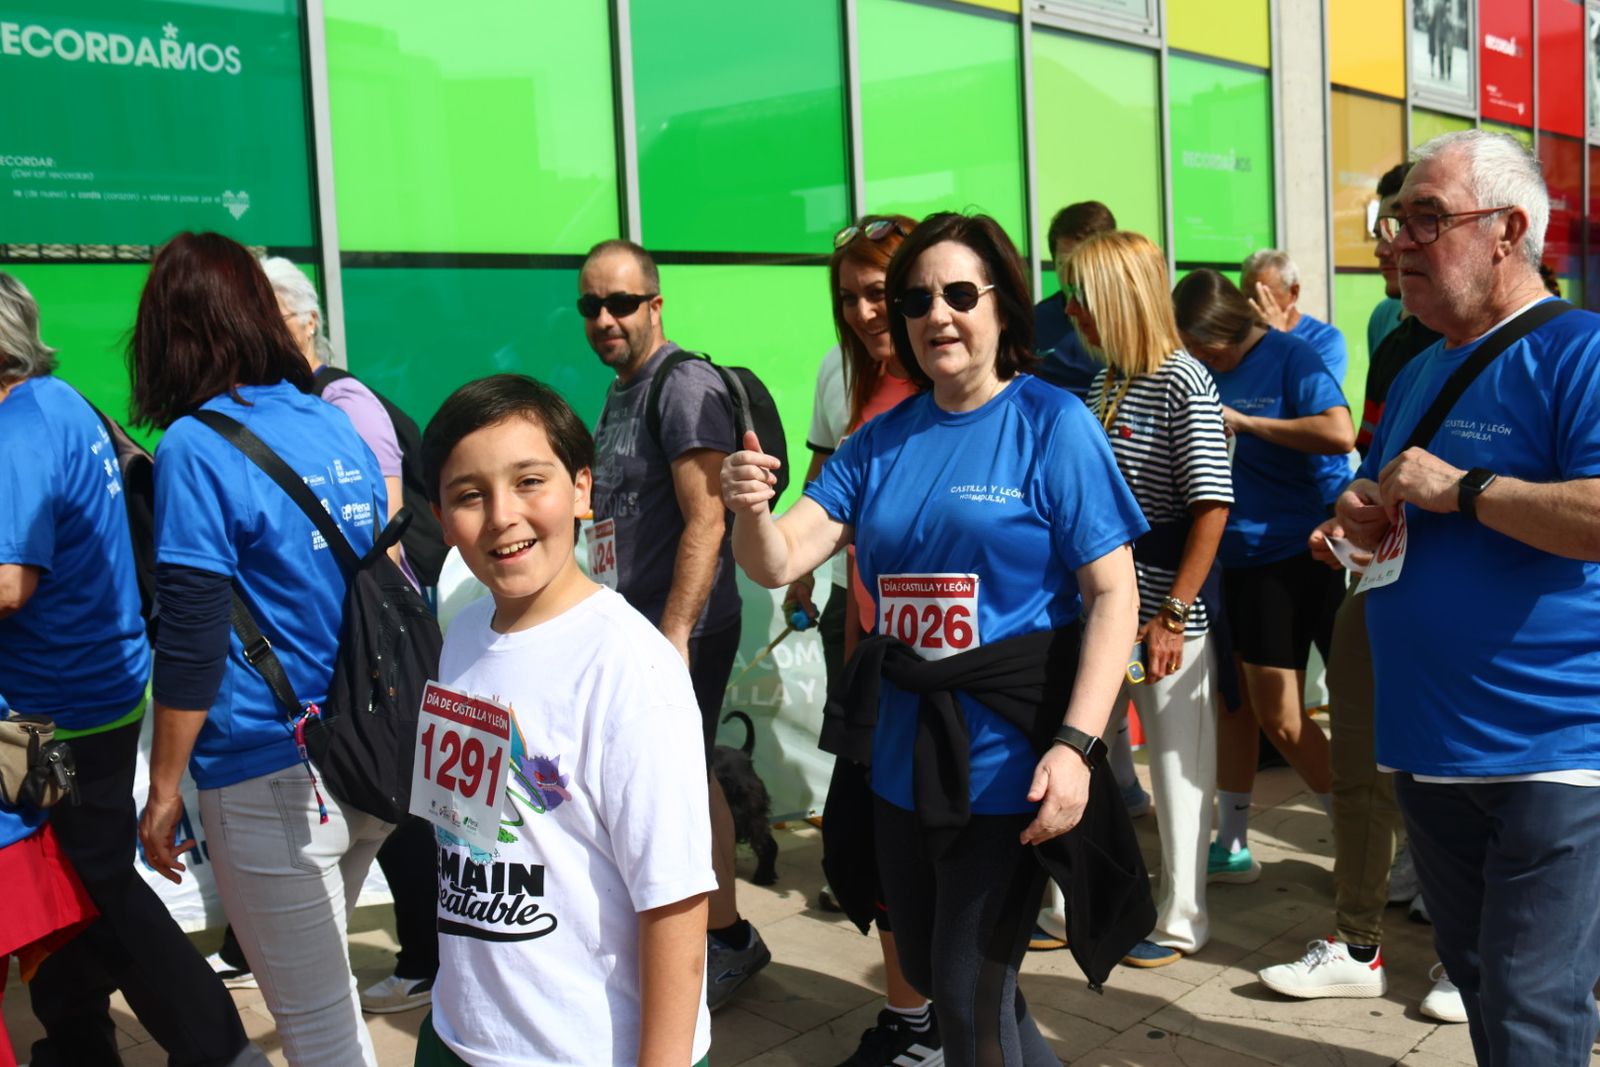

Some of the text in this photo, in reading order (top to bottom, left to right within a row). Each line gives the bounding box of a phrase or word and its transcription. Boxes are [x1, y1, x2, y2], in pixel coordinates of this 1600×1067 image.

[0, 22, 242, 75] ECORDARMOS
[950, 484, 1025, 499] CASTILLA Y LEÓN
[901, 582, 935, 592] CASTILLA
[935, 582, 943, 592] Y
[943, 580, 971, 592] LEÓN
[884, 603, 974, 650] 1026
[426, 692, 508, 731] DÍA DE CASTILLA Y LEÓN
[722, 683, 794, 708] LLA
[421, 723, 503, 808] 1291
[438, 847, 545, 897] MAIN
[439, 881, 550, 928] eatable
